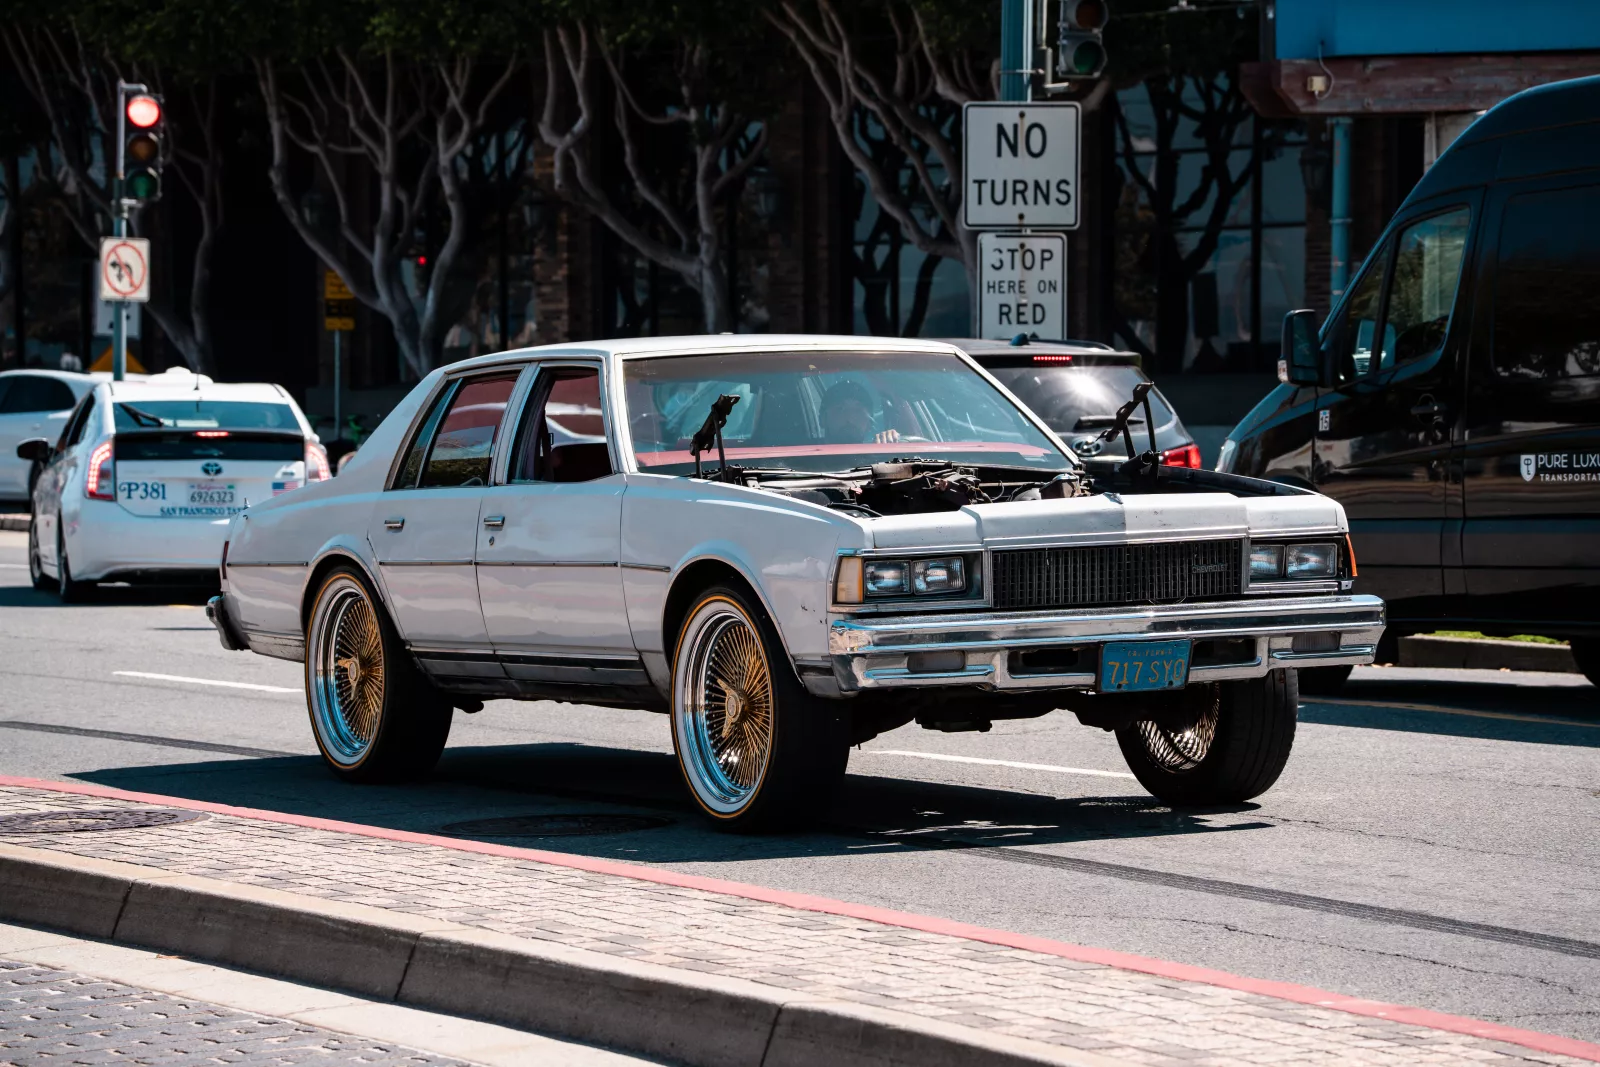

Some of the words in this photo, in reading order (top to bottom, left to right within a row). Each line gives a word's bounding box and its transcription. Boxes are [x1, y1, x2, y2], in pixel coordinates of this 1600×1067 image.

[997, 122, 1047, 158] NO
[973, 178, 1072, 206] TURNS
[991, 248, 1054, 271] STOP
[987, 279, 1026, 294] HERE
[1037, 279, 1058, 294] ON
[999, 303, 1046, 325] RED
[1537, 453, 1568, 468] PURE
[118, 481, 167, 500] P381
[160, 506, 177, 516] SAN
[179, 506, 225, 515] FRANCISCO
[1108, 661, 1143, 685] 717
